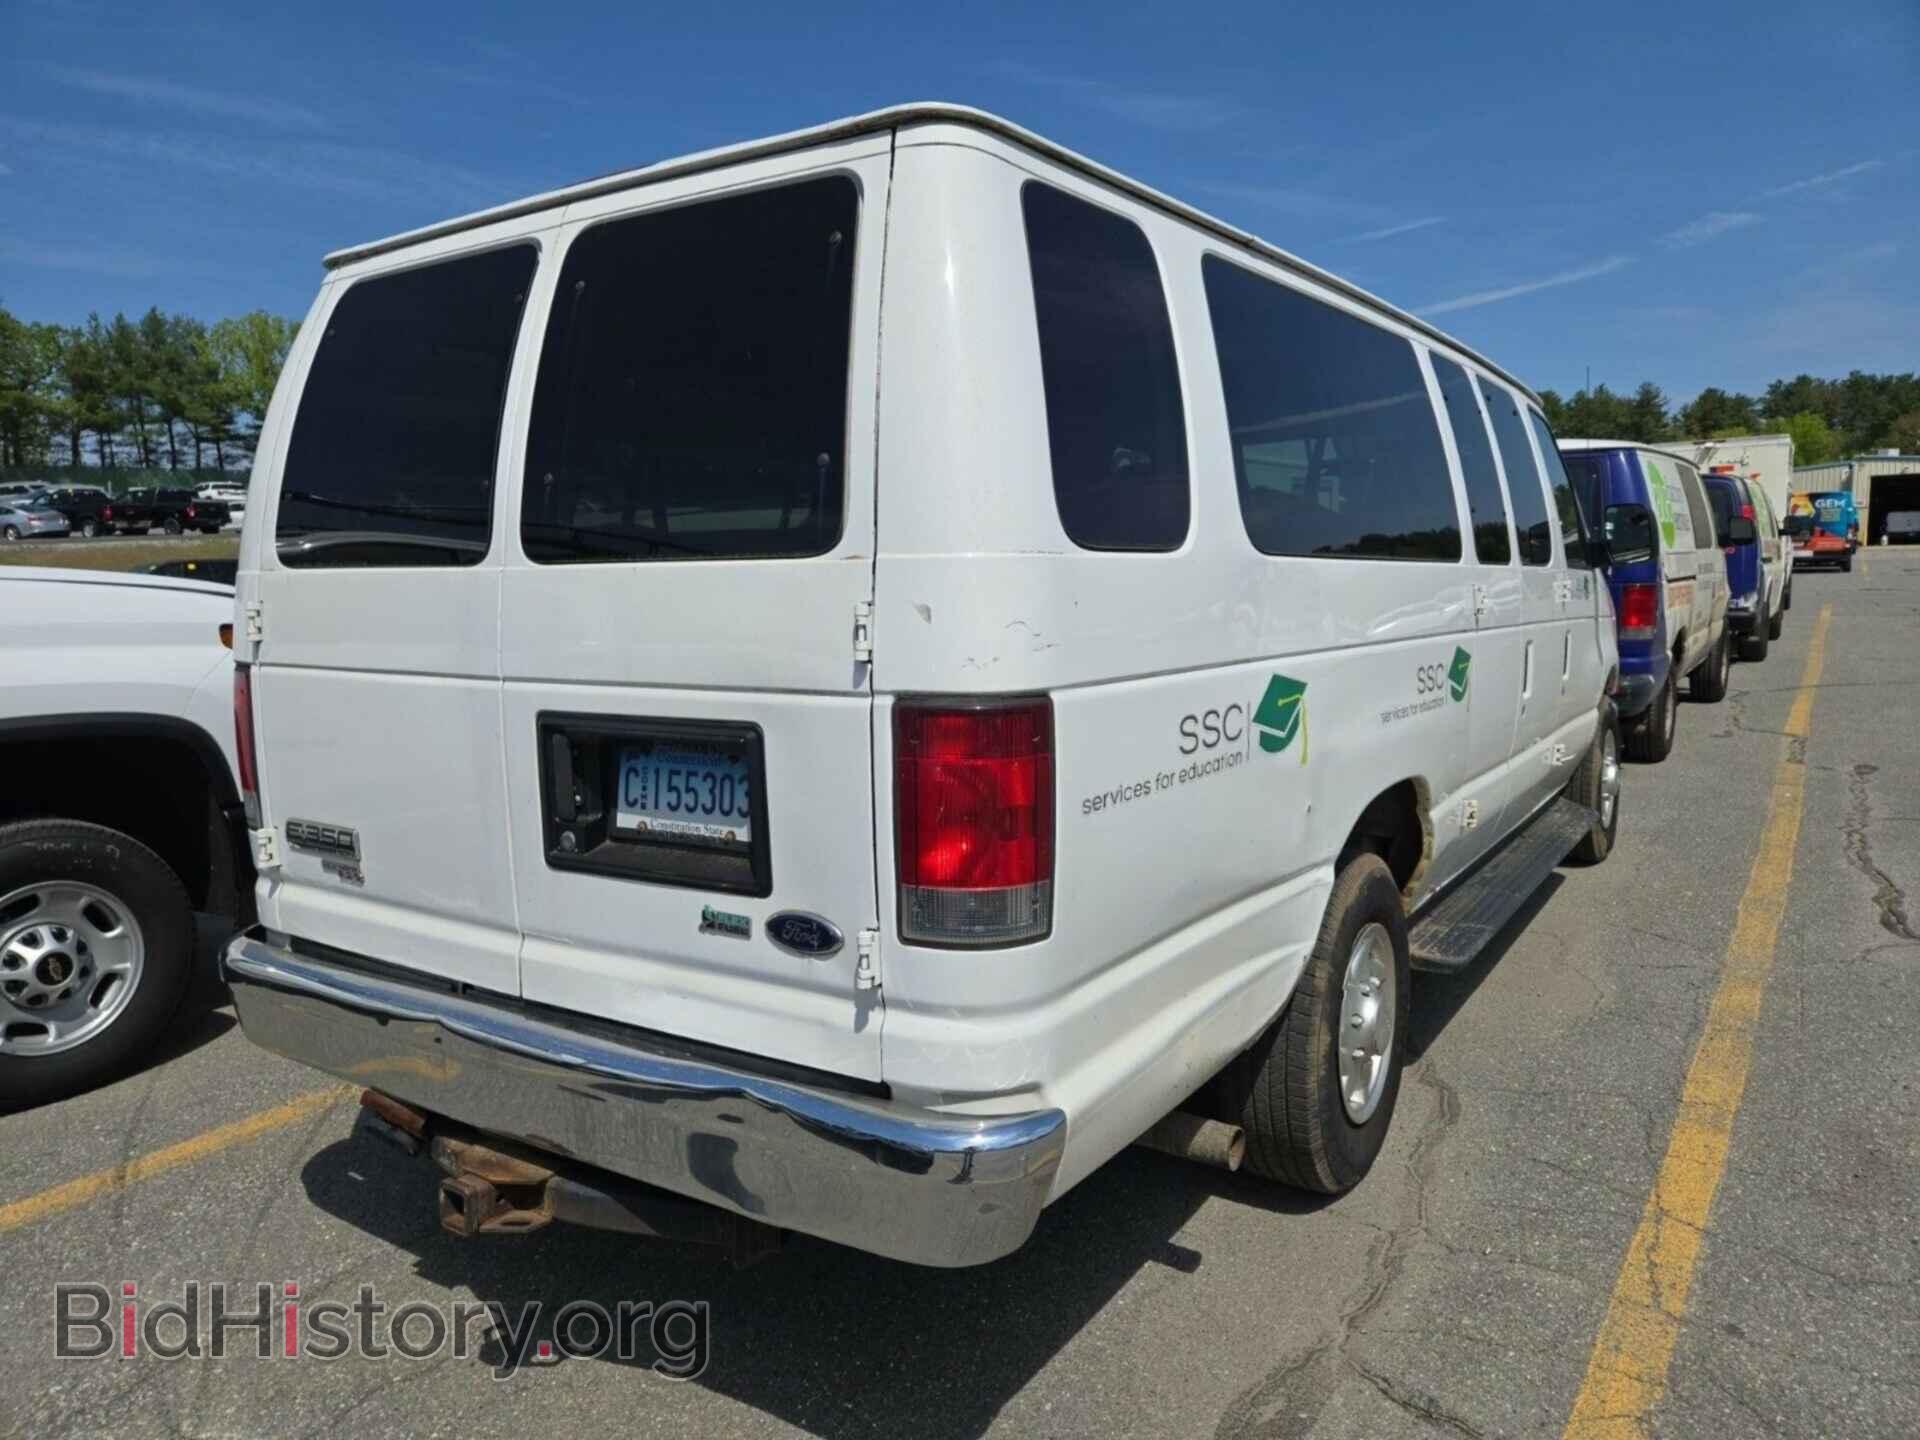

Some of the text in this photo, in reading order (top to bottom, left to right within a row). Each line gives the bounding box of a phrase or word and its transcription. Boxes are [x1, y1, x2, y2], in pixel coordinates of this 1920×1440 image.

[1417, 662, 1444, 695] SSC
[1179, 703, 1243, 755] SSC
[1082, 750, 1242, 815] services for education
[783, 920, 821, 950] Ford
